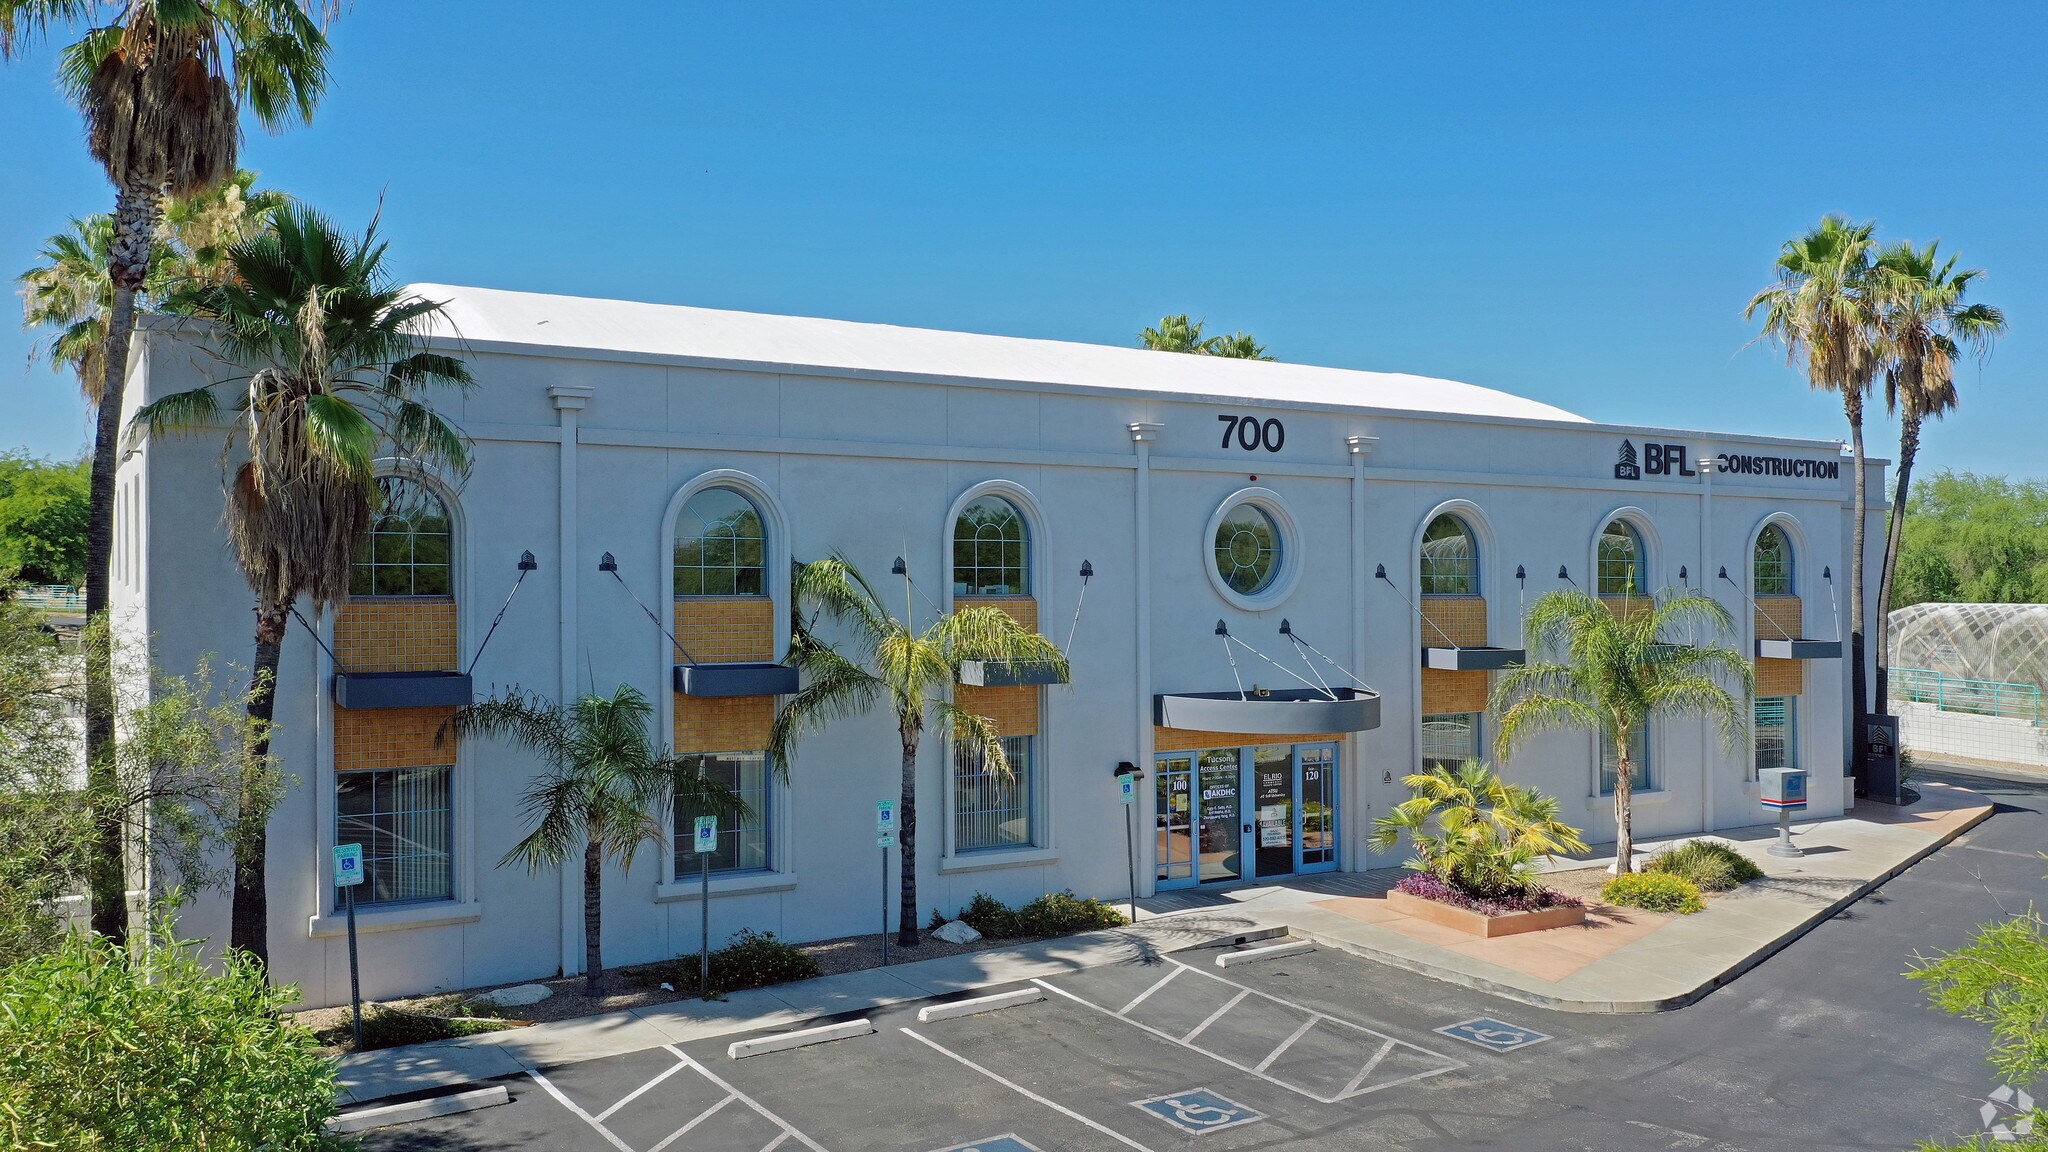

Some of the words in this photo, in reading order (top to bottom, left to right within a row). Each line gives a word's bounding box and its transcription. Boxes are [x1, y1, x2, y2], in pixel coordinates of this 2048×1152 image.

[1218, 415, 1285, 453] 700
[1644, 443, 1696, 476] BFL
[1717, 453, 1839, 479] CONSTRUCTION
[1619, 465, 1636, 477] BFL
[1271, 772, 1283, 780] RIO
[1306, 771, 1319, 780] 120
[1173, 781, 1187, 790] 100
[1211, 788, 1236, 797] AKDHC
[1261, 820, 1287, 828] AVAILABLE
